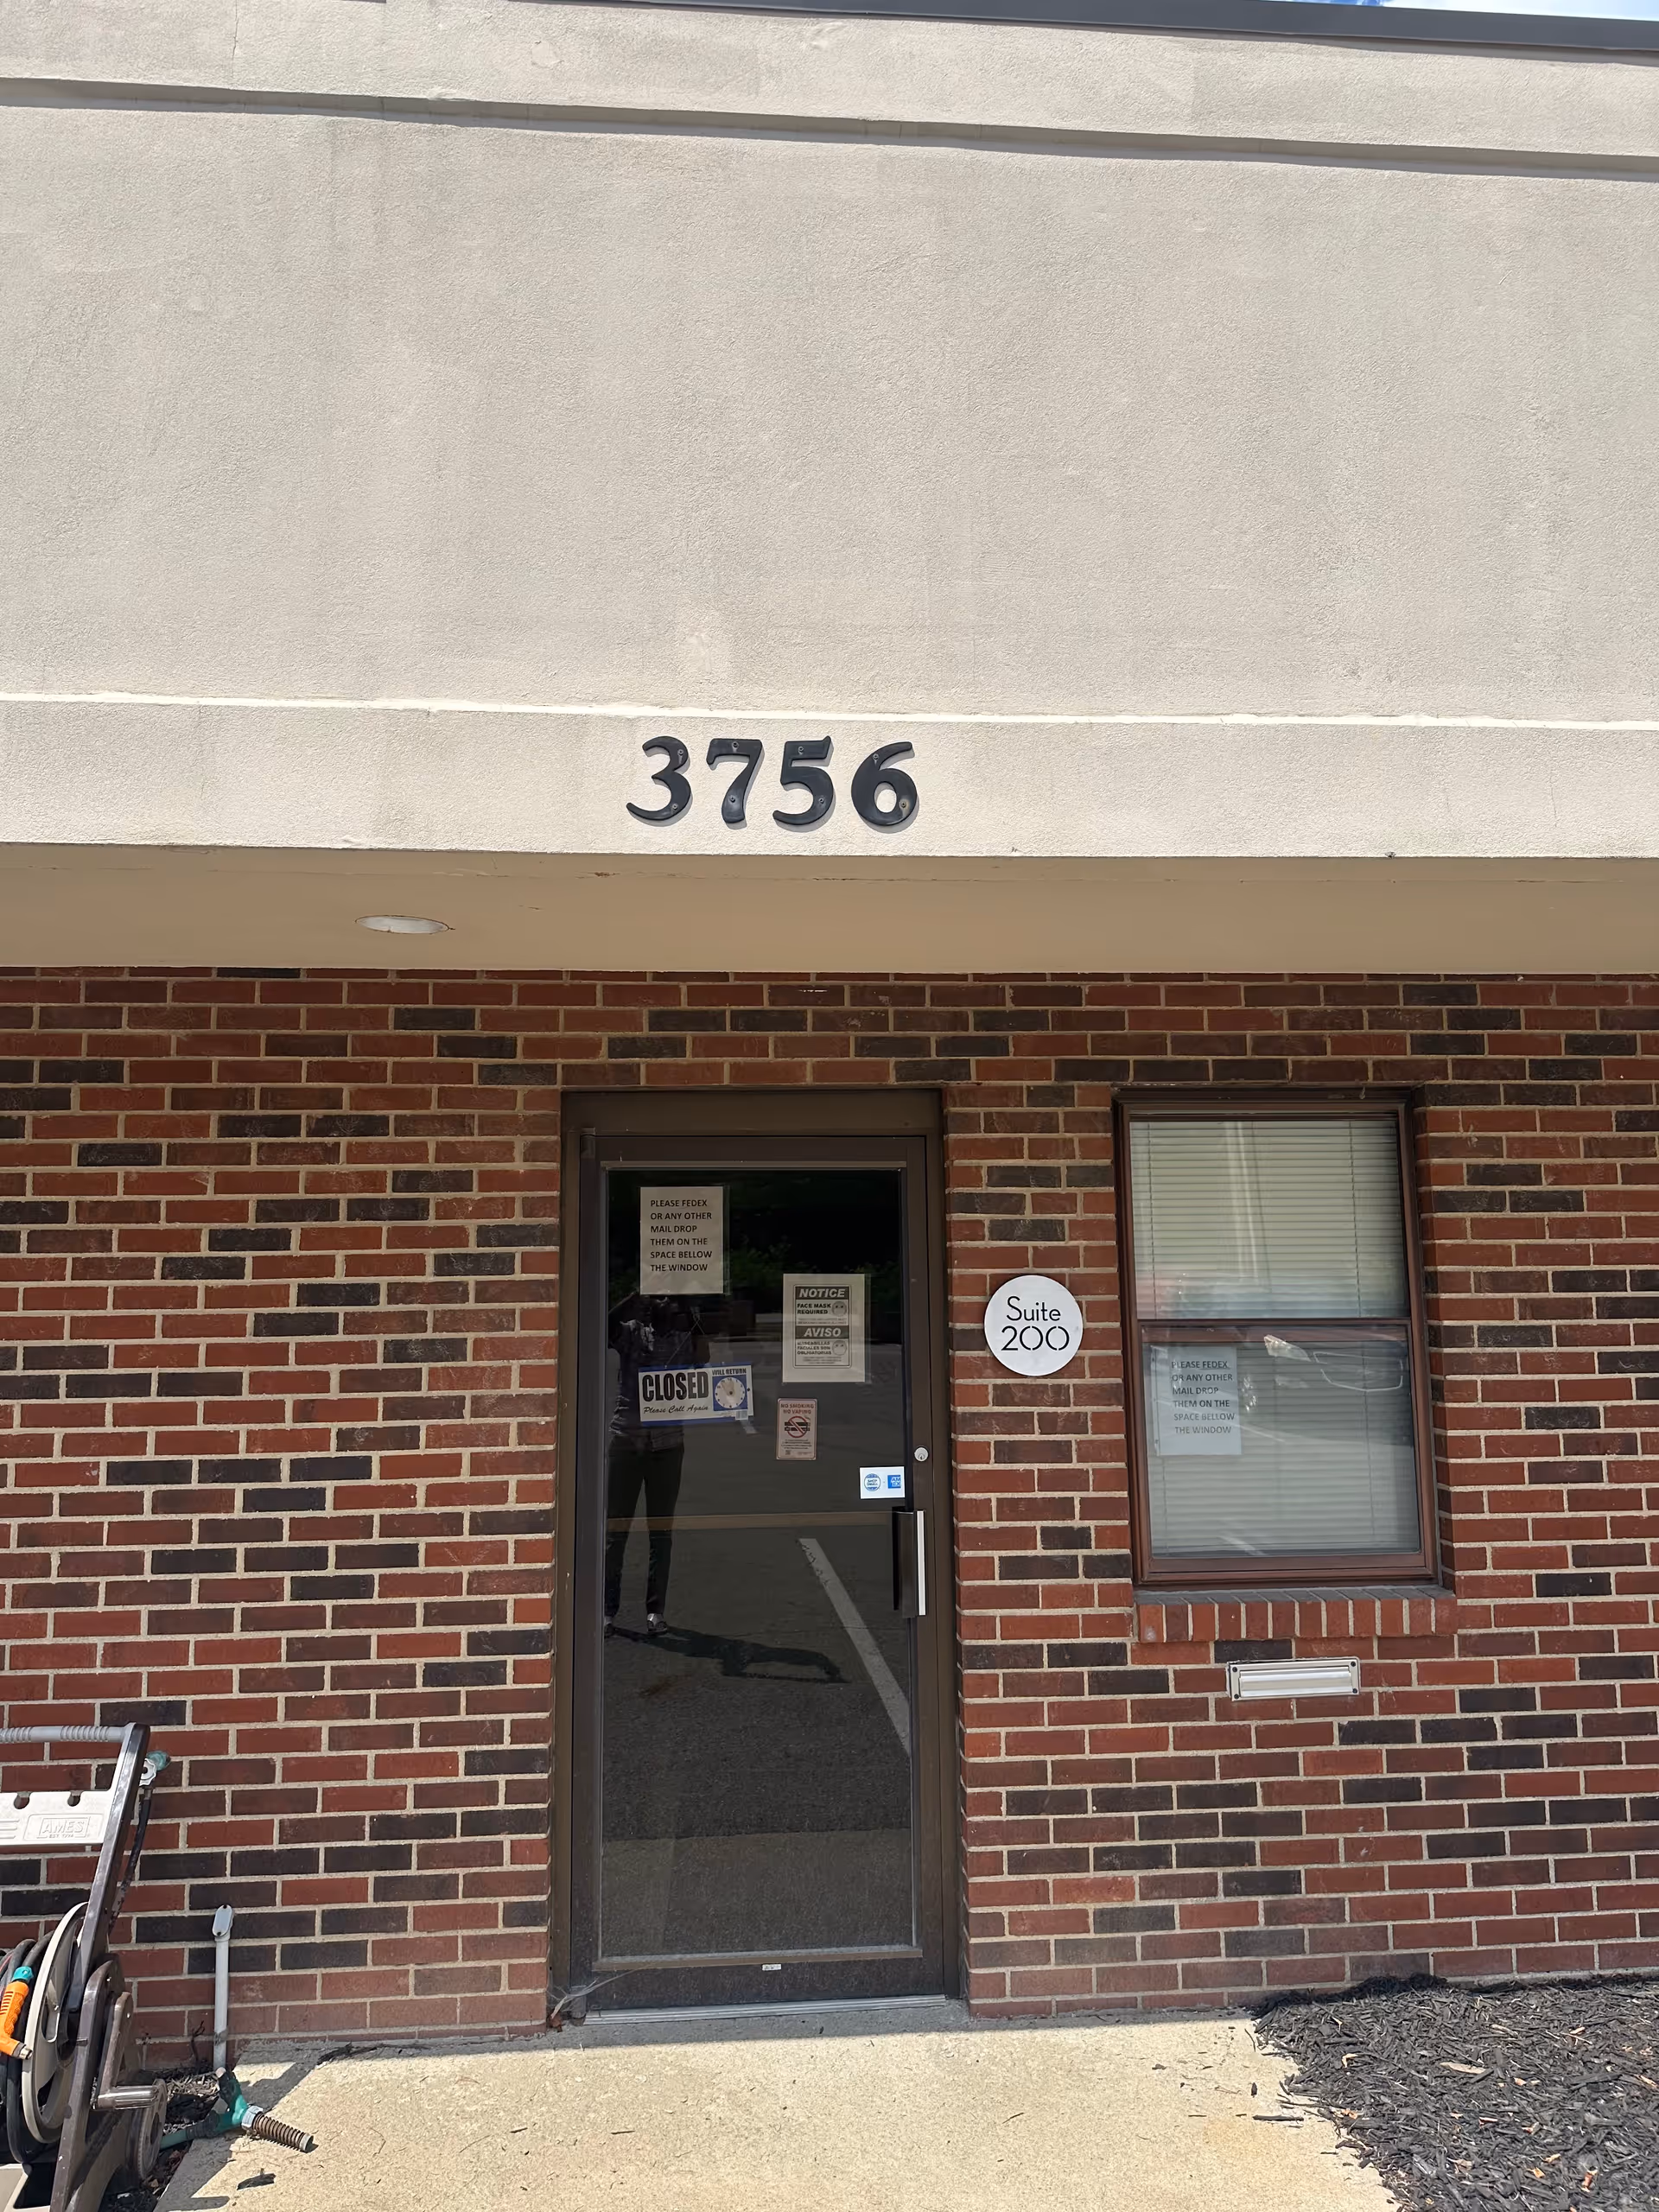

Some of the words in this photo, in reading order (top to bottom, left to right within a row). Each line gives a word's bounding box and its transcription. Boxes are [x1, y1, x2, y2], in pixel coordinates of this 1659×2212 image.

[626, 735, 919, 832] 3756
[799, 1288, 846, 1298] NOTICE
[1006, 1295, 1061, 1322] Suite
[804, 1327, 842, 1337] AVISO
[1001, 1325, 1070, 1351] 200
[642, 1371, 709, 1402] CLOSED
[668, 1405, 684, 1414] Call
[687, 1404, 709, 1413] Again
[42, 1821, 85, 1834] AMES
